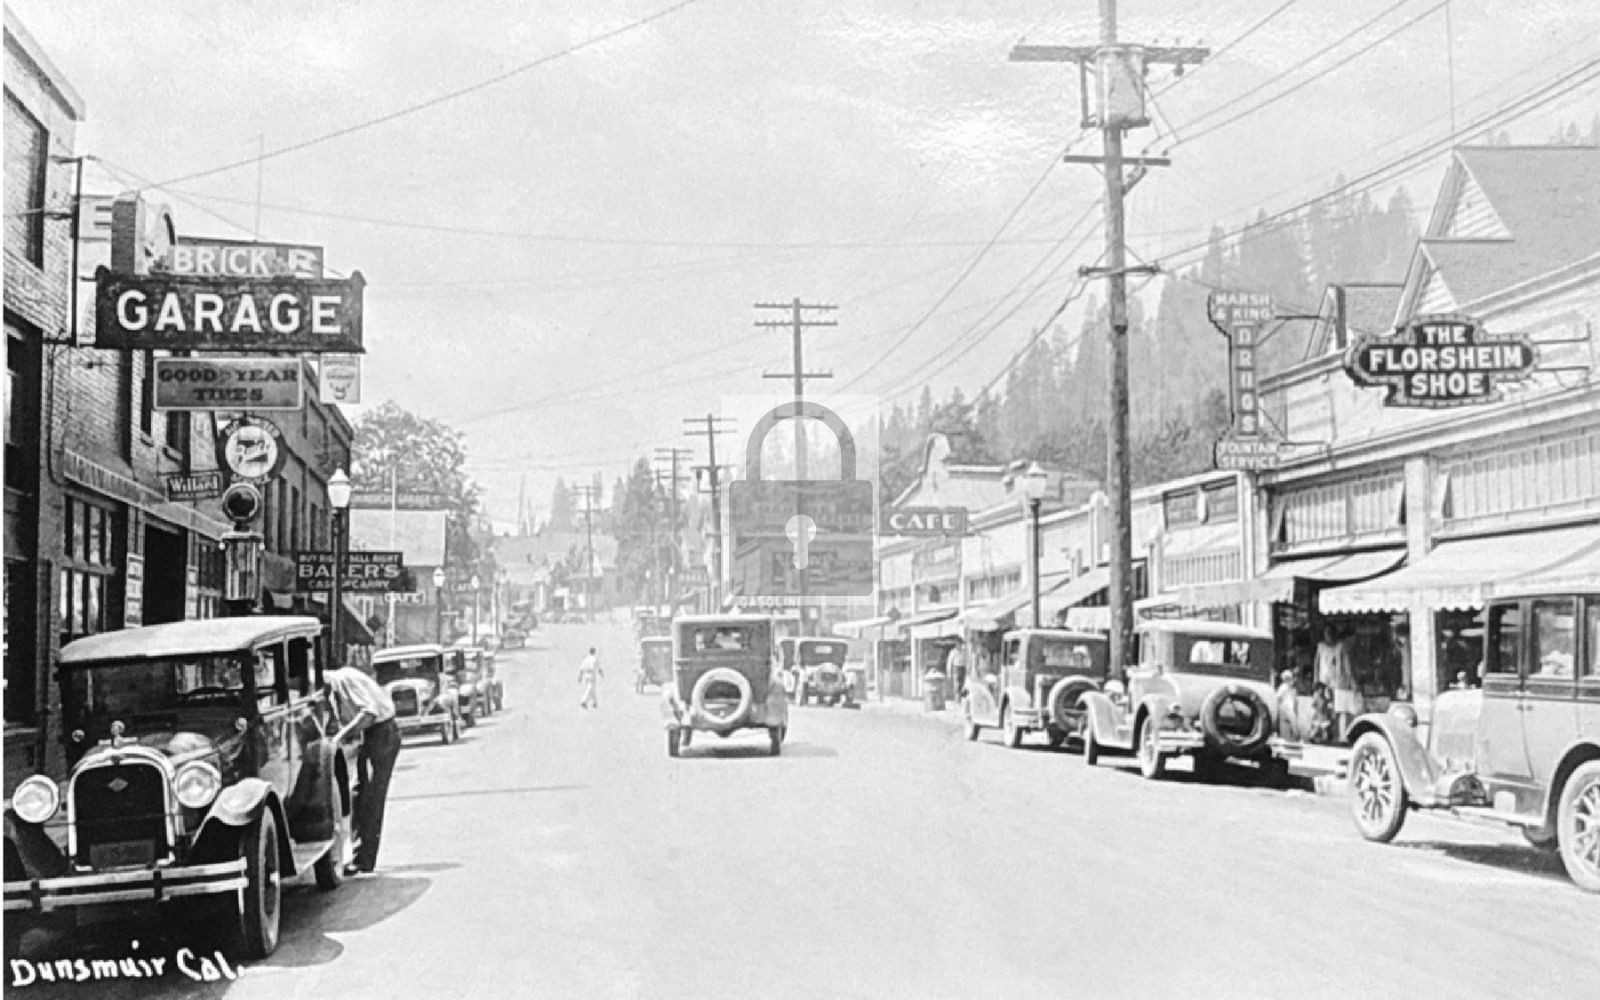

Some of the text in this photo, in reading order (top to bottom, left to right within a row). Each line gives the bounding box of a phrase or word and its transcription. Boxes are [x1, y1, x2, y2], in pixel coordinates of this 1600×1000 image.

[174, 246, 268, 275] BRICK
[116, 290, 342, 334] GARAGE
[1424, 325, 1467, 344] THE
[1369, 345, 1522, 371] FLORSHEIM
[159, 368, 297, 383] GOOD YEAR
[1239, 326, 1256, 433] DRUGS
[1411, 372, 1483, 396] SHOE
[170, 476, 218, 491] Willard
[889, 513, 956, 530] CAFE
[298, 564, 399, 579] BAER'S
